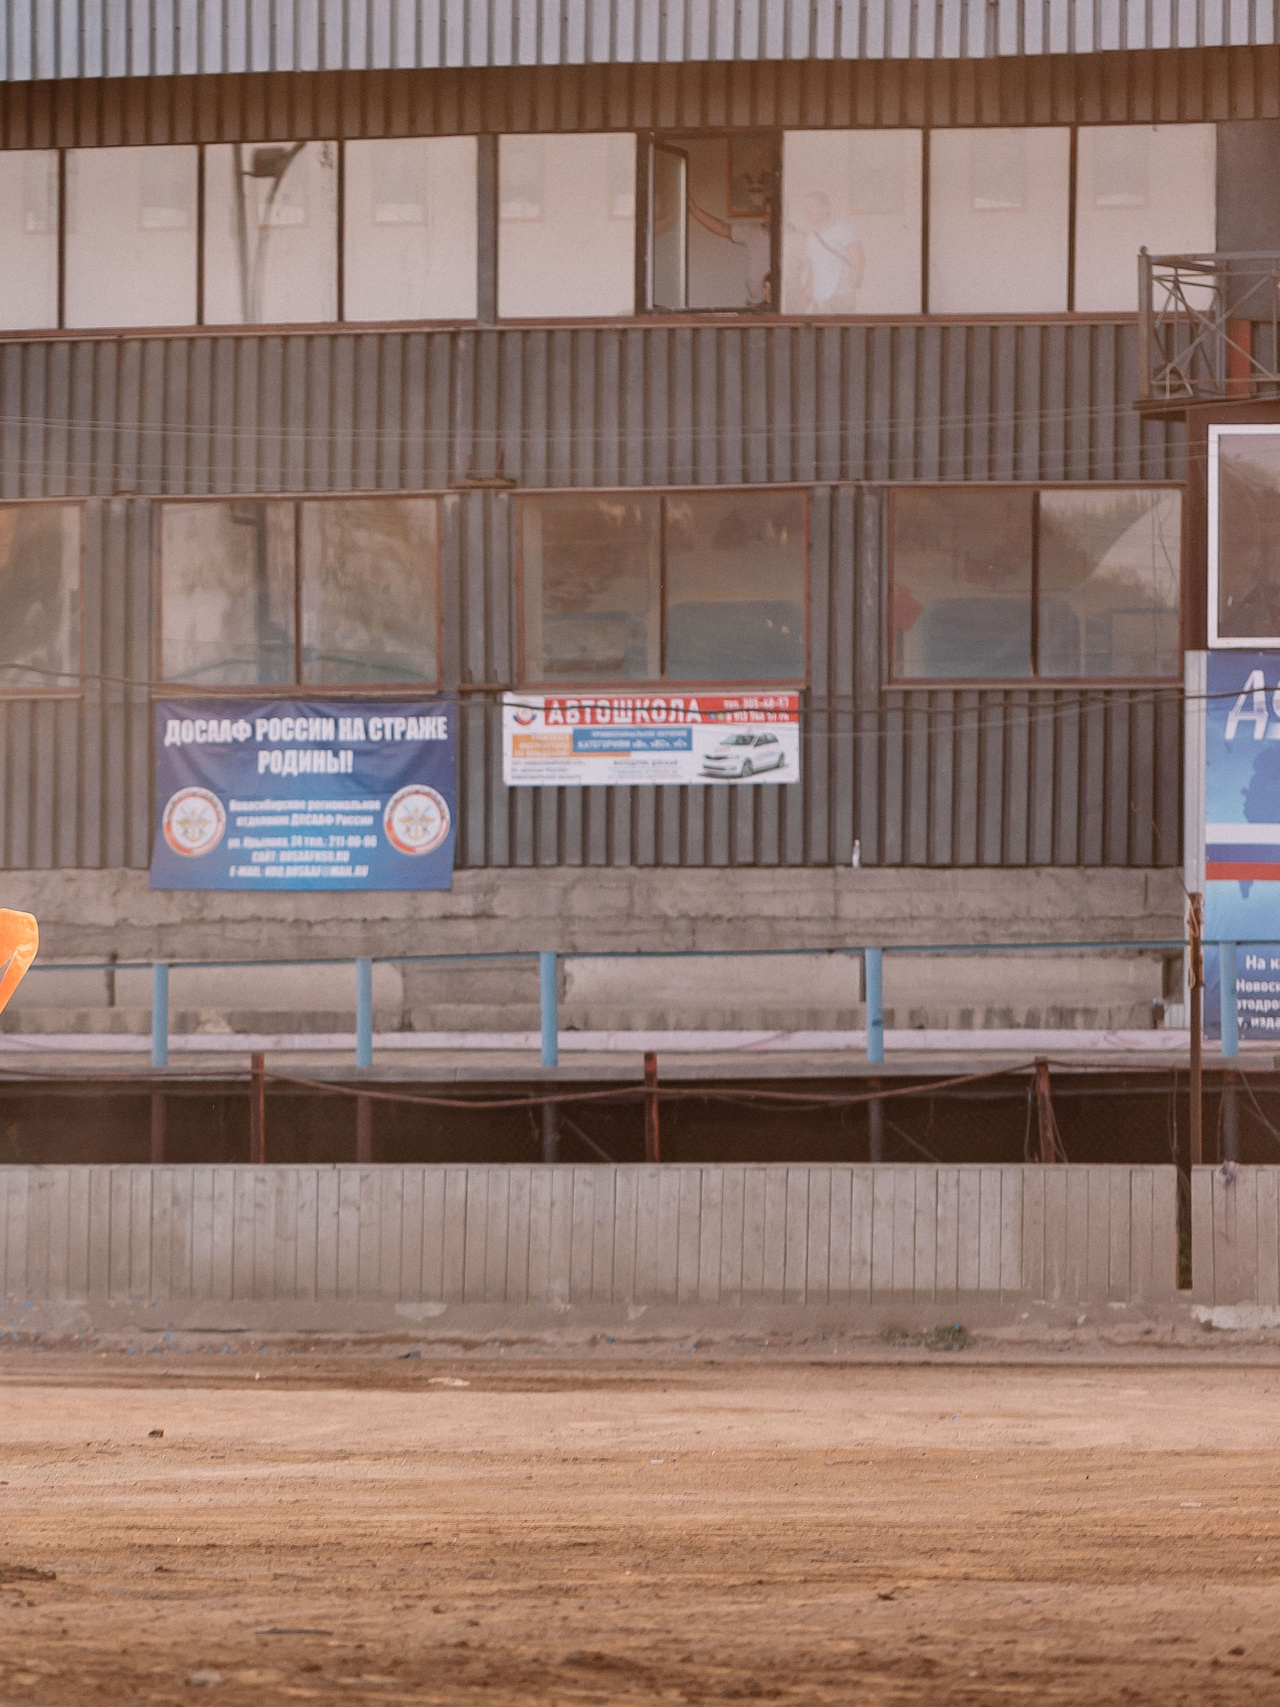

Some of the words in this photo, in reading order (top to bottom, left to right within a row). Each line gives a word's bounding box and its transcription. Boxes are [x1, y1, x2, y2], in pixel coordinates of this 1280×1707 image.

[548, 697, 702, 724] АВТОШКОЛА
[165, 718, 252, 746] ДОСААФ
[255, 717, 336, 742] РОССИИ
[338, 717, 366, 741] НА
[370, 716, 448, 741] СТРАЖЕ
[258, 750, 354, 776] РОДИНЫ!
[1245, 954, 1266, 970] На
